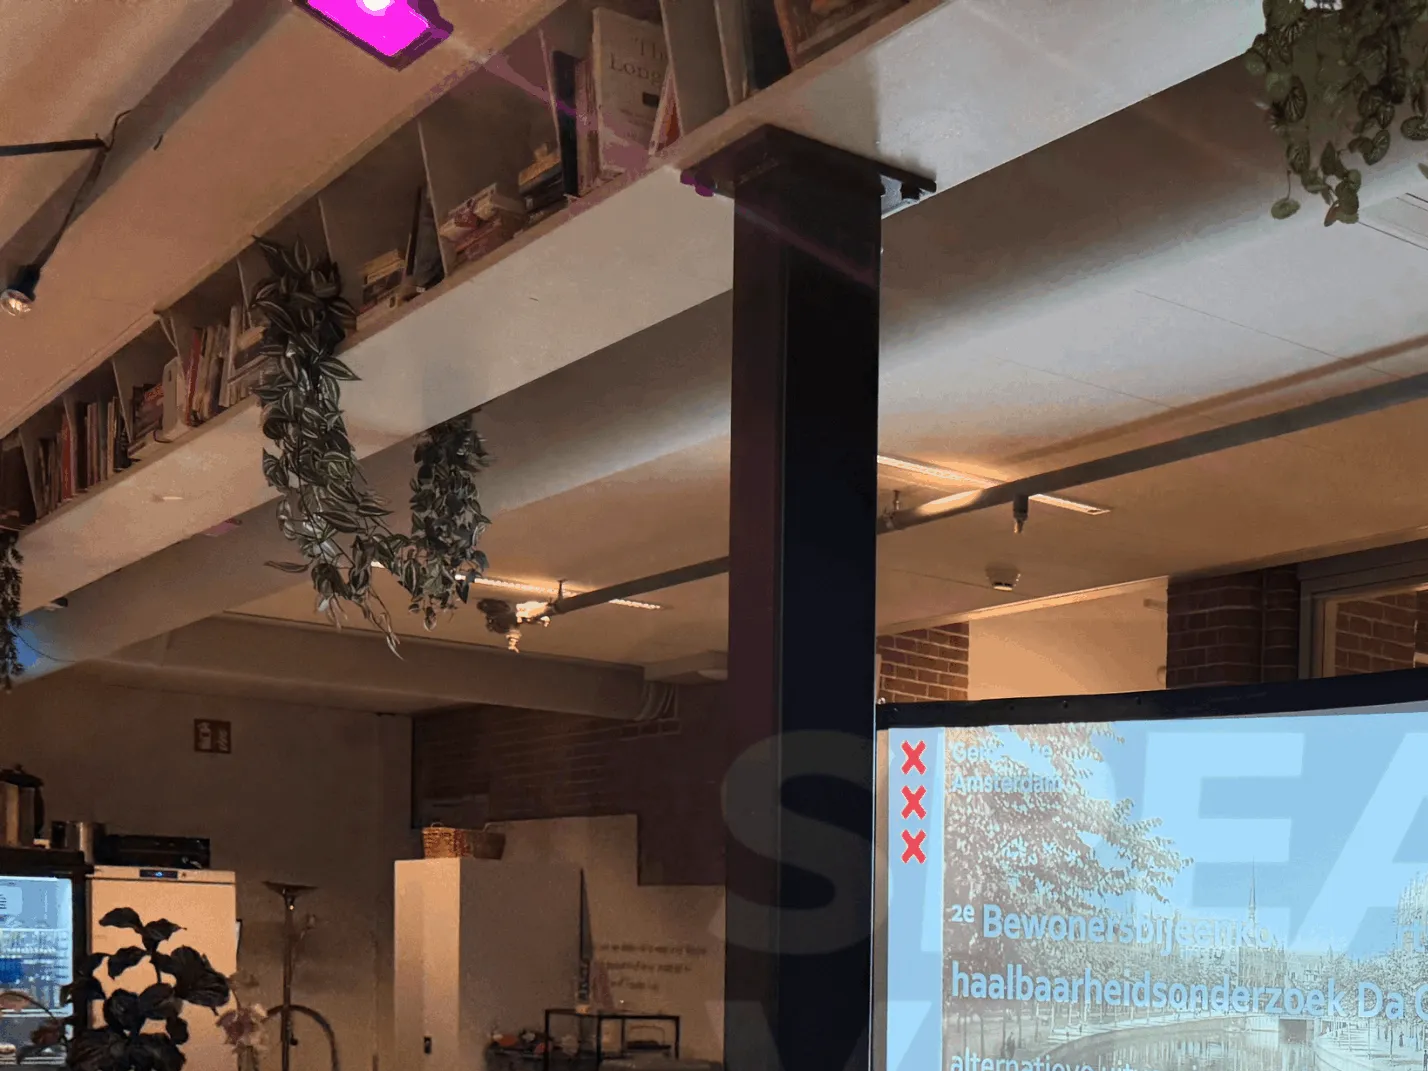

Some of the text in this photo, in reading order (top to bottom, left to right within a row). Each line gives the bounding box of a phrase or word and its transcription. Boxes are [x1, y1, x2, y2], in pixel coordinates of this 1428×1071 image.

[951, 769, 1063, 793] Amsterdam
[951, 904, 975, 923] 2e
[983, 903, 1280, 956] Bewonersbijeenko
[952, 960, 1347, 1019] haalbaarheidsonderzoek
[1358, 981, 1405, 1020] Da
